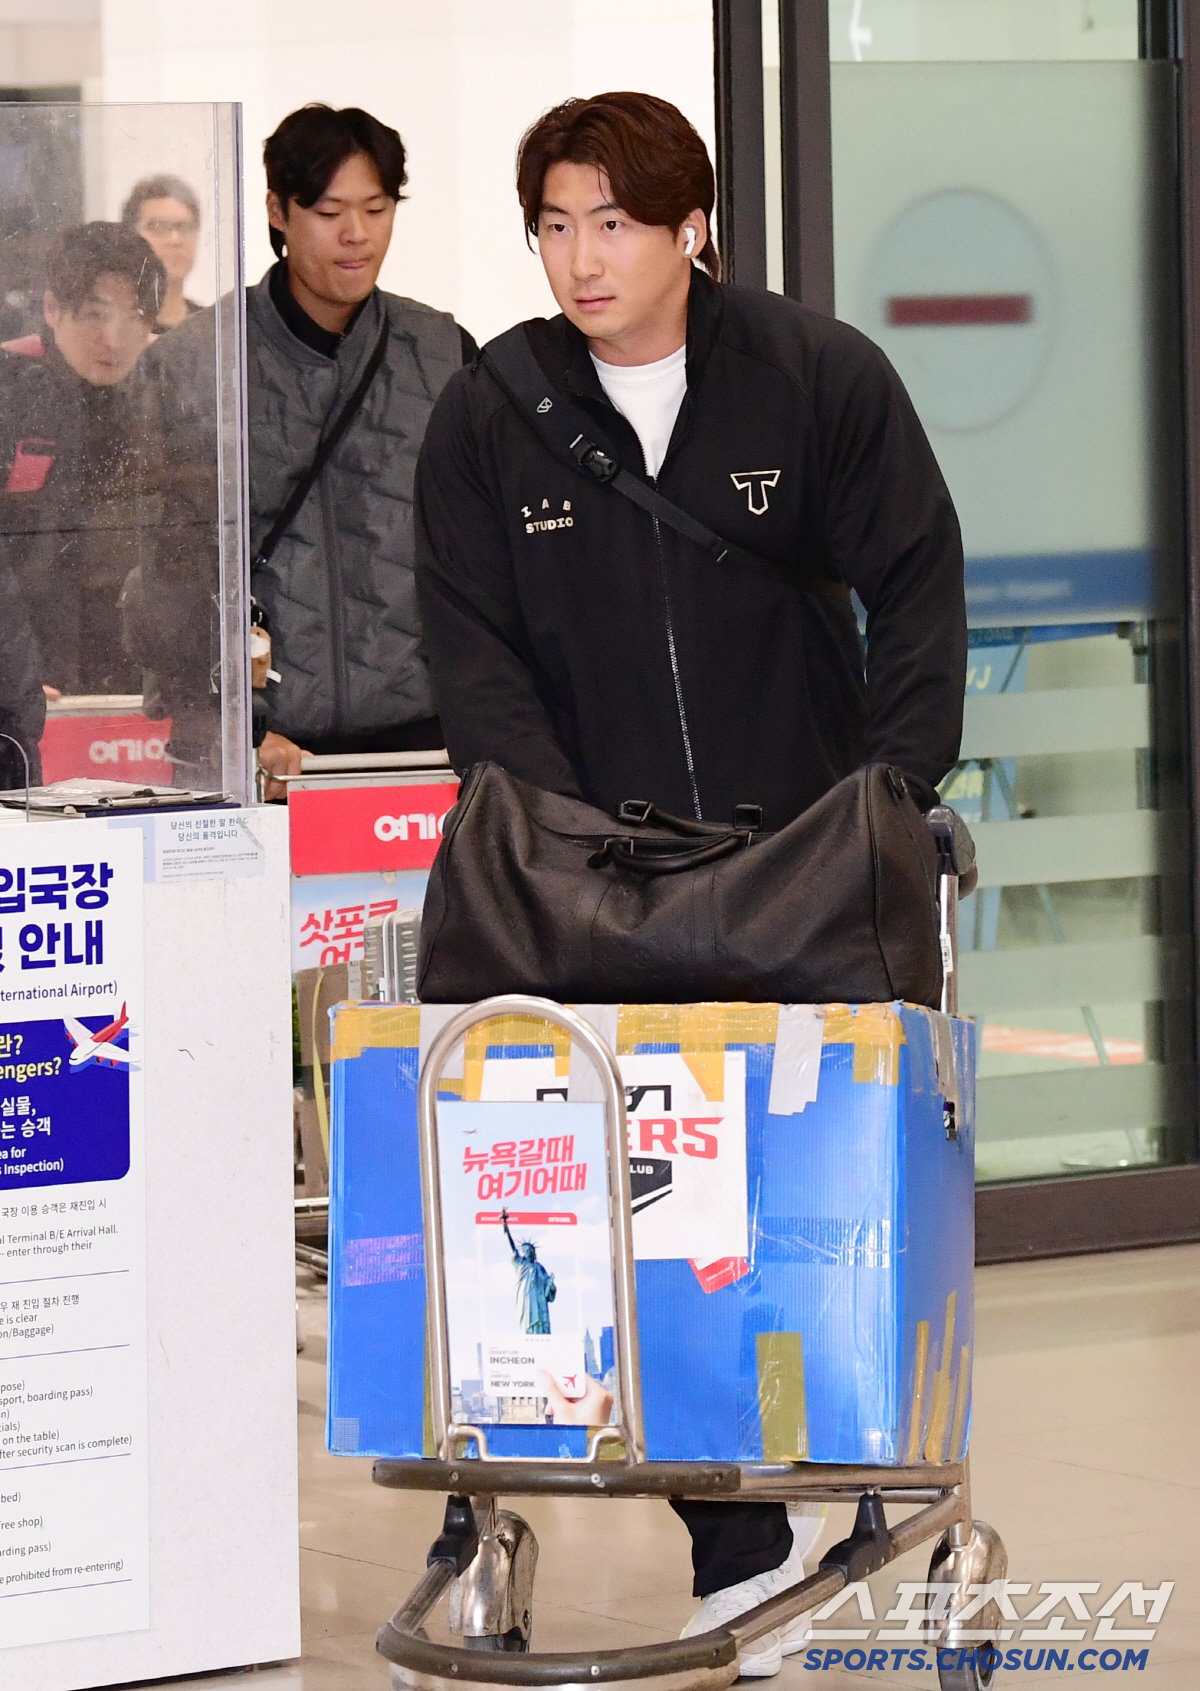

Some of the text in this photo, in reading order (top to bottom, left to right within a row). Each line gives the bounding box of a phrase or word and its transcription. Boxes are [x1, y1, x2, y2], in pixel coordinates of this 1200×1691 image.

[525, 517, 574, 534] STUDIO
[170, 820, 192, 830] 당신의
[374, 808, 451, 842] 여기
[0, 862, 113, 914] 입국장
[19, 920, 104, 970] 안내
[0, 980, 118, 1001] ternational Airport)
[1, 1096, 36, 1117] 실물,
[0, 1116, 51, 1139] 는 승객
[11, 1146, 26, 1158] for
[462, 1134, 575, 1174] 뉴욕갈때
[4, 1158, 64, 1177] Inspection)
[477, 1162, 588, 1200] 여기어때
[1, 1198, 107, 1218] 국장 이용 승객은 재진입 시
[8, 1231, 47, 1244] Terminal
[50, 1229, 64, 1241] B/E
[67, 1226, 96, 1238] Arrival
[99, 1224, 119, 1235] Hall.
[6, 1240, 93, 1258] enter through their
[11, 1300, 20, 1310] 재
[22, 1298, 39, 1310] 진입
[42, 1296, 60, 1308] 절차
[62, 1294, 80, 1305] 진행
[6, 1315, 14, 1325] is
[15, 1313, 38, 1324] clear
[0, 1380, 25, 1394] pose)
[490, 1380, 535, 1388] NEW YORK
[27, 1389, 68, 1402] boarding
[70, 1386, 93, 1399] pass)
[0, 1409, 10, 1420] n)
[0, 1421, 21, 1432] ials)
[16, 1434, 31, 1443] the
[33, 1430, 60, 1442] table)
[17, 1444, 53, 1456] security
[55, 1442, 76, 1452] scan
[78, 1440, 86, 1450] is
[87, 1434, 132, 1449] complete)
[0, 1492, 21, 1503] bed)
[0, 1516, 43, 1530] ree shop)
[28, 1541, 52, 1555] pass)
[6, 1567, 51, 1585] prohibited
[52, 1565, 73, 1576] from
[74, 1558, 124, 1574] re-entering)
